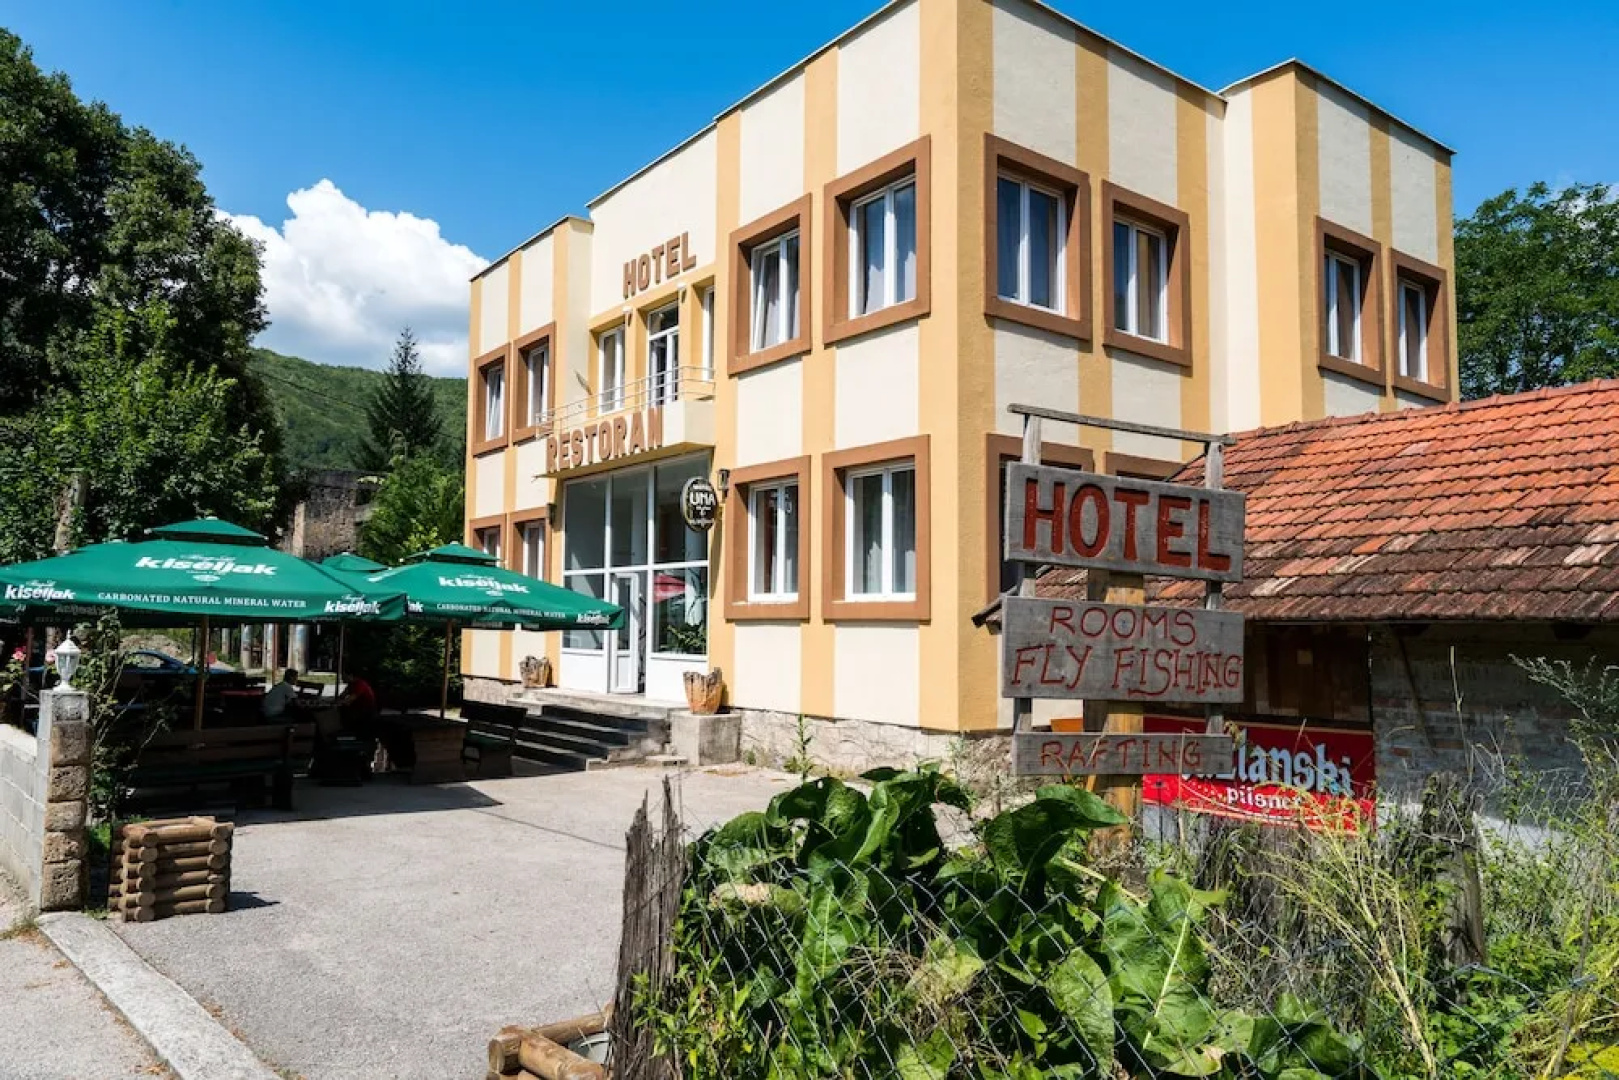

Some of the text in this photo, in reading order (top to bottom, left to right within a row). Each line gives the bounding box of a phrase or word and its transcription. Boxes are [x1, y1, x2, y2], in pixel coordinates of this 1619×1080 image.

[623, 231, 697, 299] HOTEL
[546, 404, 664, 473] RESTORAN
[1023, 477, 1231, 572] HOTEL
[135, 556, 279, 576] kiseljak
[5, 584, 76, 601] kiseljak
[98, 592, 307, 608] CARBONATED NATURAL MINERAL WATER
[438, 576, 530, 594] kiseljak
[324, 600, 380, 615] kiseljak
[1050, 606, 1196, 646] ROOMS
[1011, 644, 1244, 697] FLY FISHING
[1041, 739, 1201, 769] RAFTING
